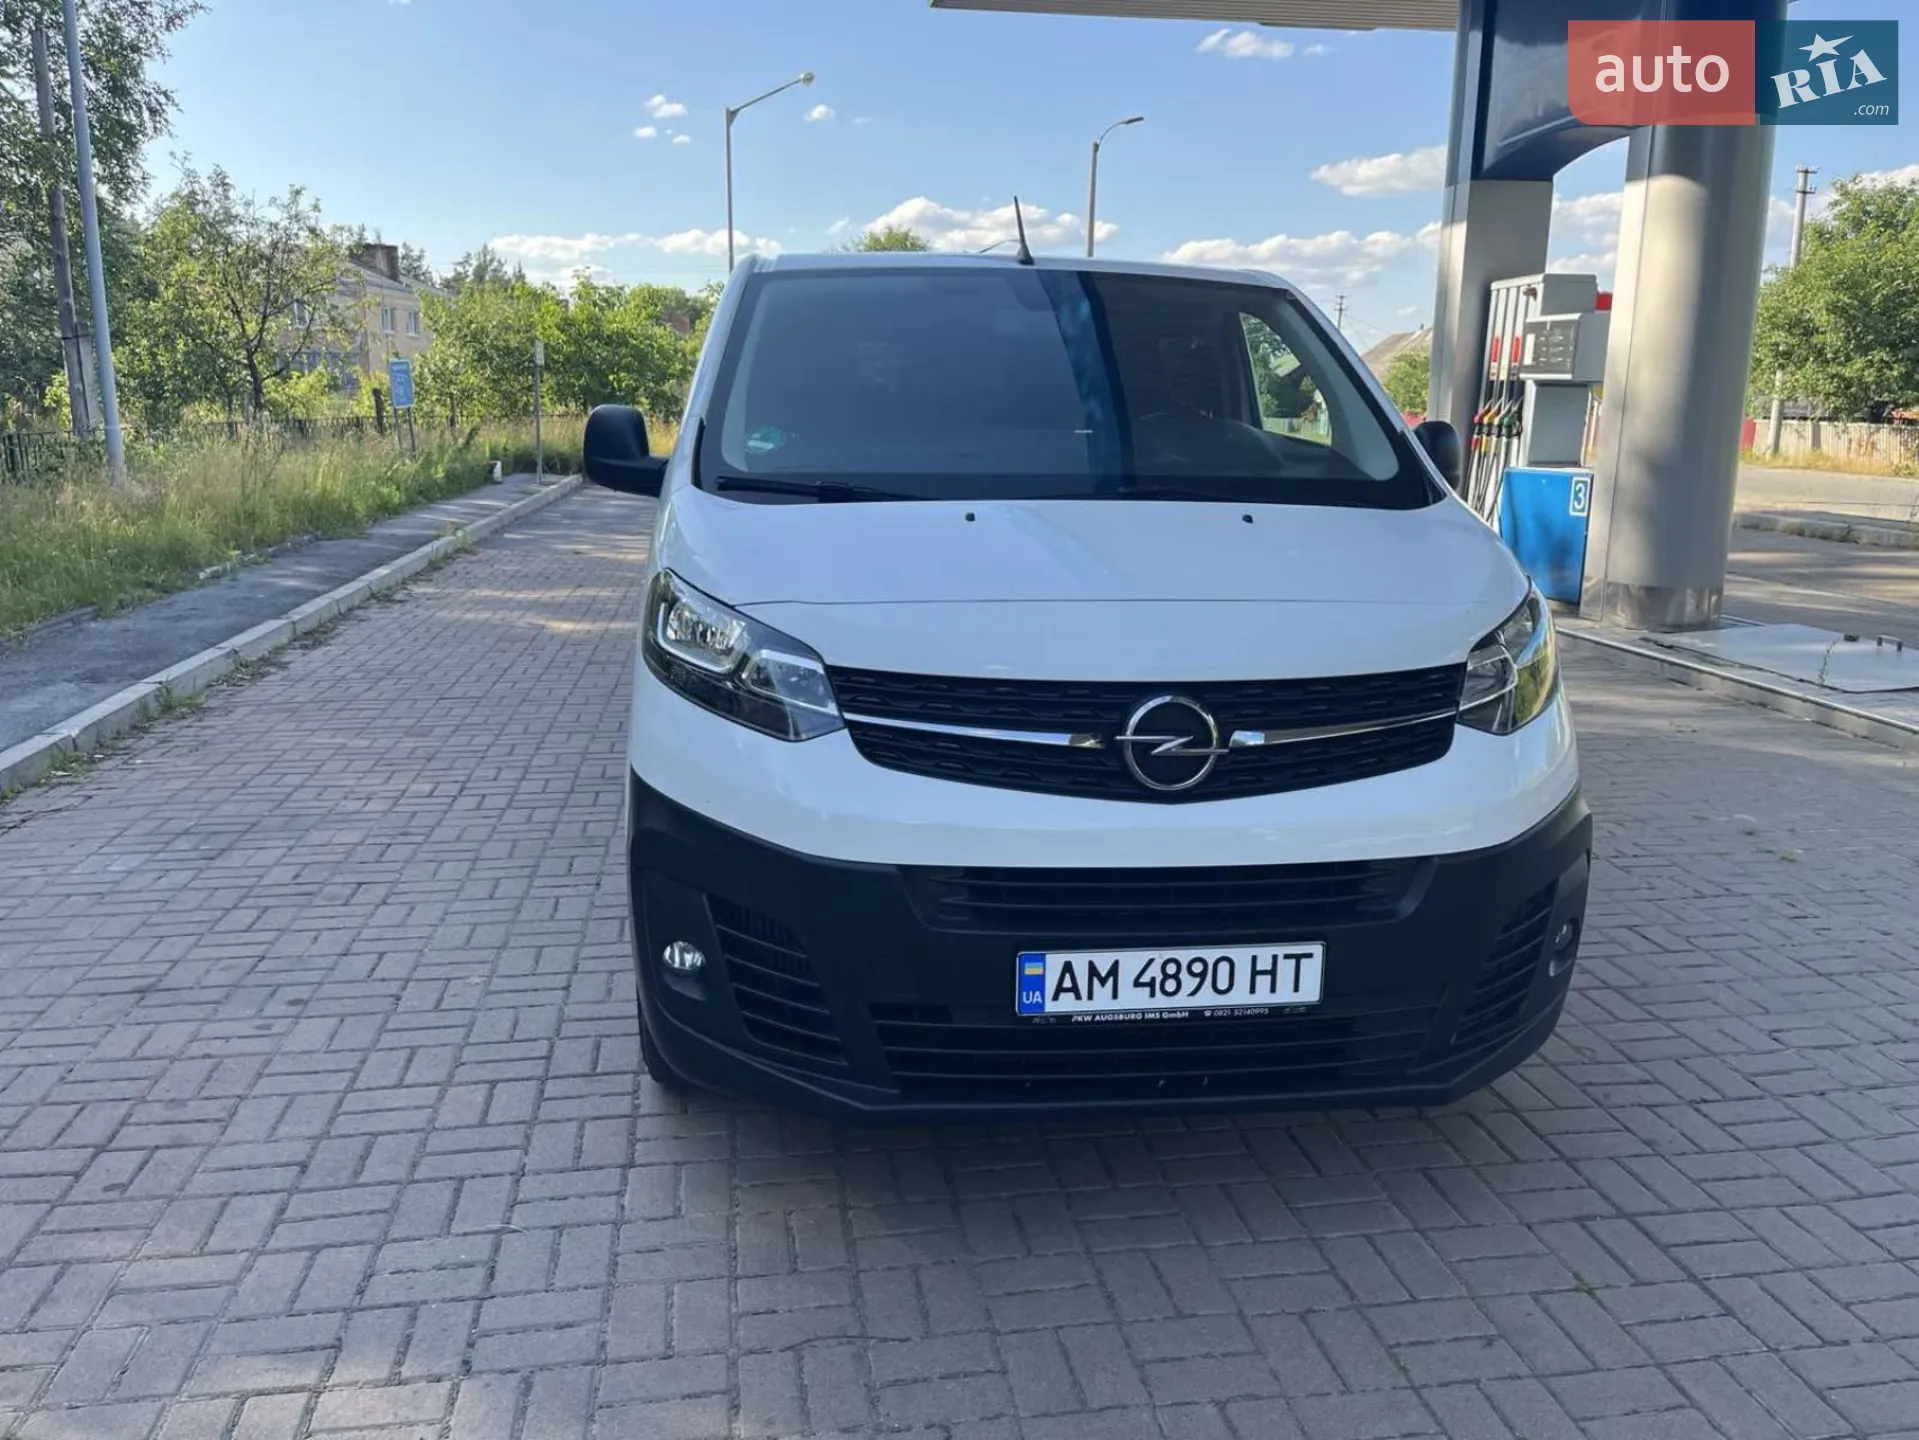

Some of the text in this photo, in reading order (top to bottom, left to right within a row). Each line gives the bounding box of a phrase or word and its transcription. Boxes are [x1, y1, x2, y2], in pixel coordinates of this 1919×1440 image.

[1574, 483, 1585, 509] 3
[1051, 952, 1315, 1002] AM 4890 HT
[1022, 990, 1043, 1005] UA
[1094, 1011, 1143, 1021] AUGSBURG
[1161, 1010, 1189, 1019] GmbH
